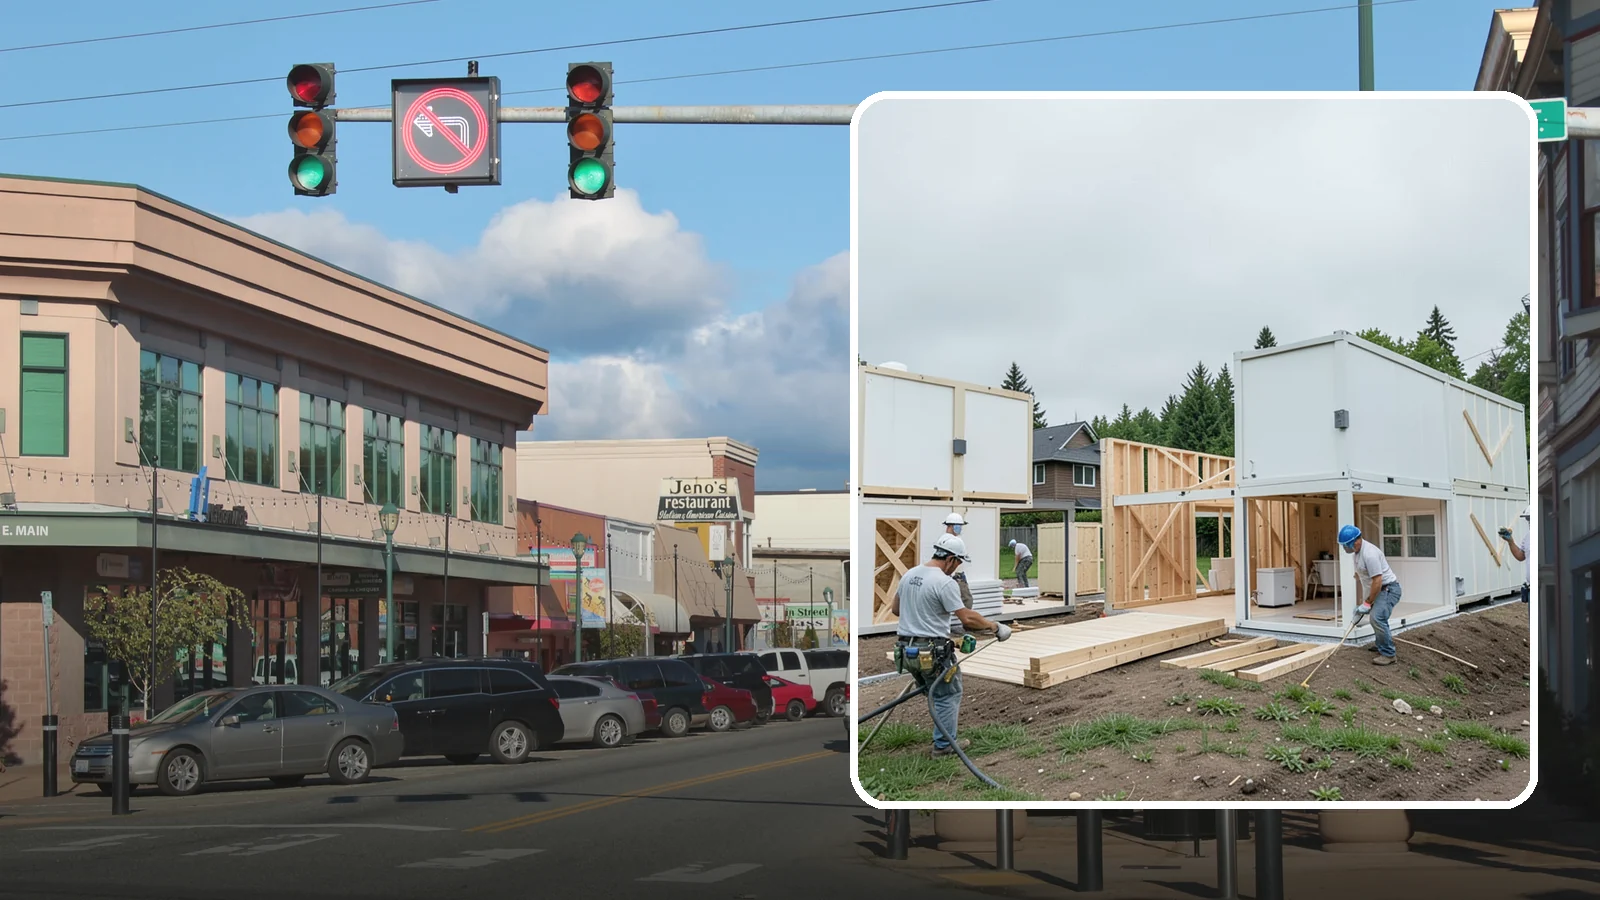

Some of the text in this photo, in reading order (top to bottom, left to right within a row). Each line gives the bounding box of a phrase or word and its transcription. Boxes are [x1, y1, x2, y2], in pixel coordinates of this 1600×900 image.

[670, 480, 727, 494] Jeno's
[665, 496, 730, 509] restaurant
[658, 510, 682, 520] Italian
[686, 510, 714, 519] American
[715, 510, 737, 519] Cuisine
[2, 525, 49, 536] E. MAIN
[797, 607, 828, 617] Street
[791, 619, 823, 627] lass
